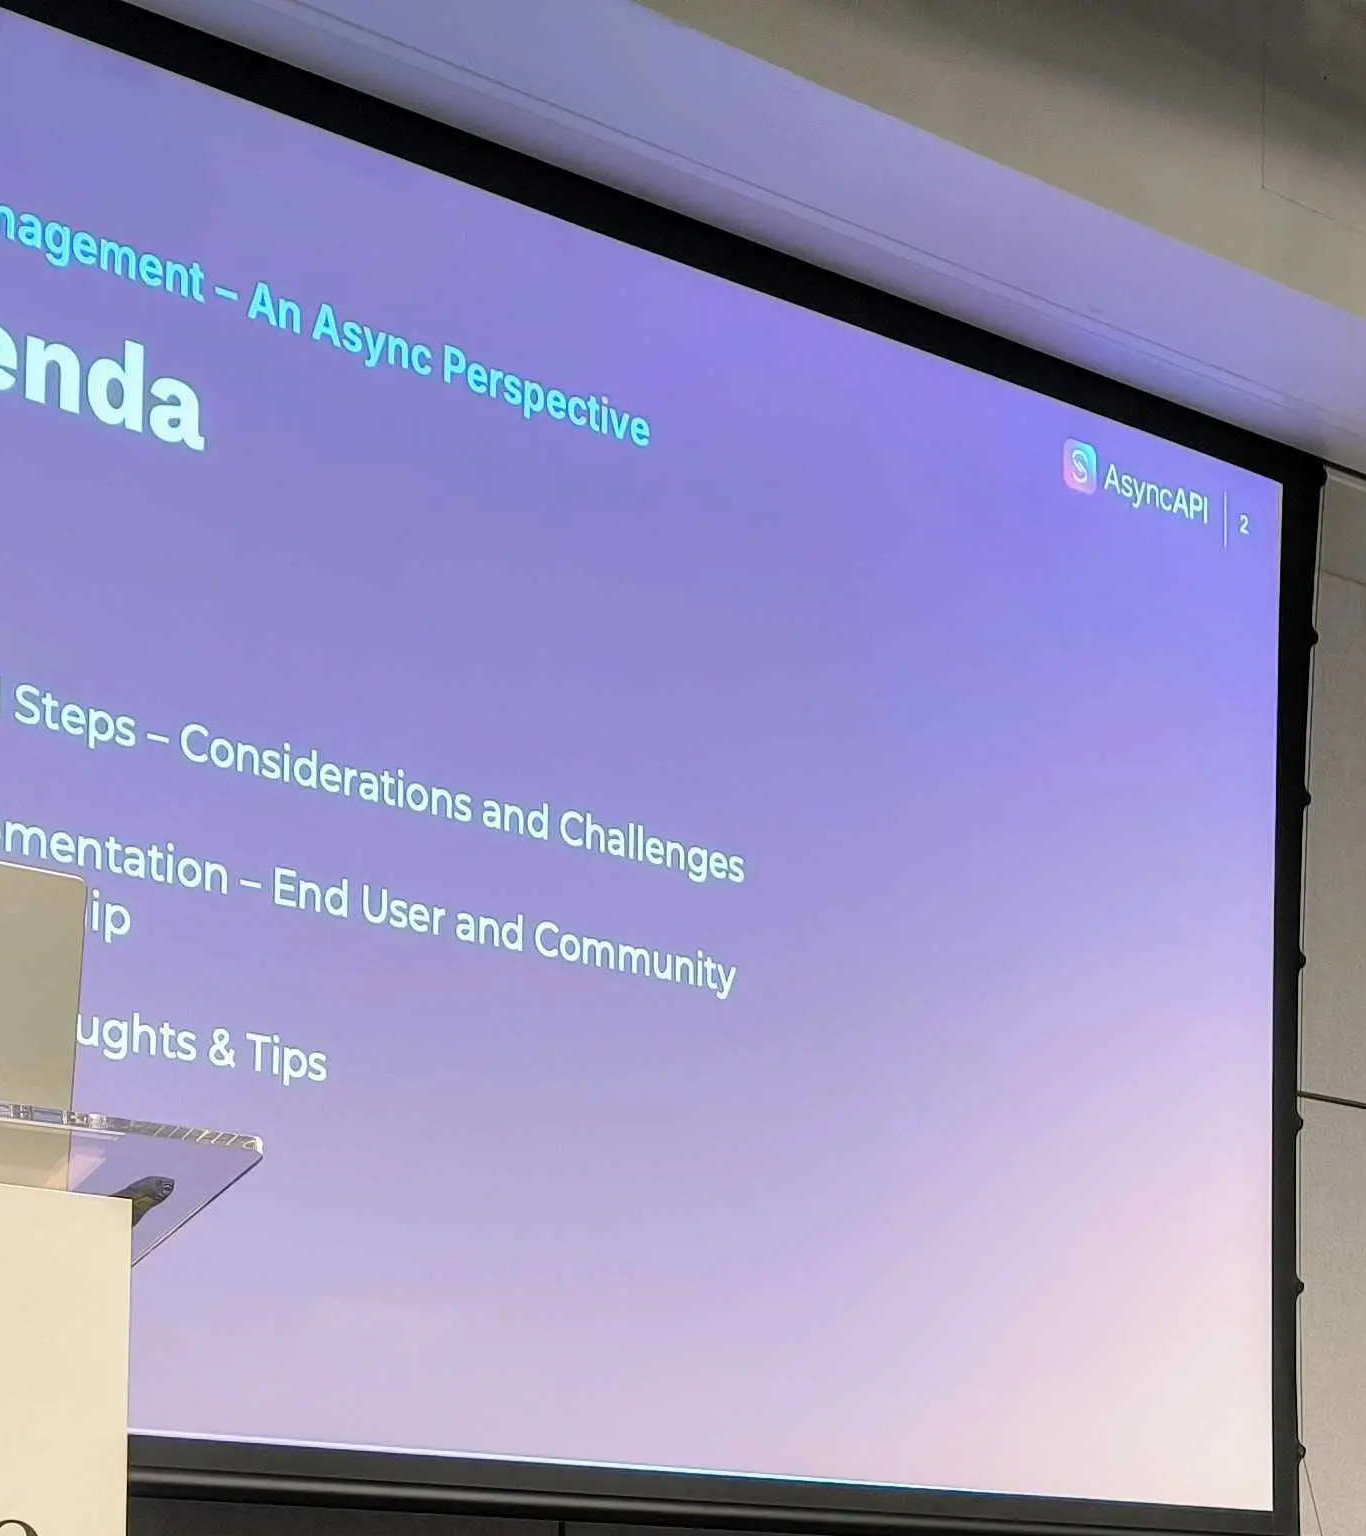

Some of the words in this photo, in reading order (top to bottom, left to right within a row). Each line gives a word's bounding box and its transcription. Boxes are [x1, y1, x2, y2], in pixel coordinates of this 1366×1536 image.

[247, 281, 301, 335] An
[311, 303, 432, 378] Async
[443, 344, 652, 447] Perspective
[1104, 463, 1208, 524] AsyncAPI
[1239, 514, 1249, 534] 2
[15, 684, 136, 750] Steps
[180, 724, 472, 824] Considerations
[481, 798, 550, 843] and
[559, 811, 746, 887] Challenges
[273, 867, 349, 920] End
[361, 884, 445, 938] User
[455, 906, 524, 953] and
[534, 921, 737, 1001] Community
[76, 1012, 197, 1061] ughts
[208, 1028, 236, 1068] &
[246, 1032, 328, 1084] Tips
